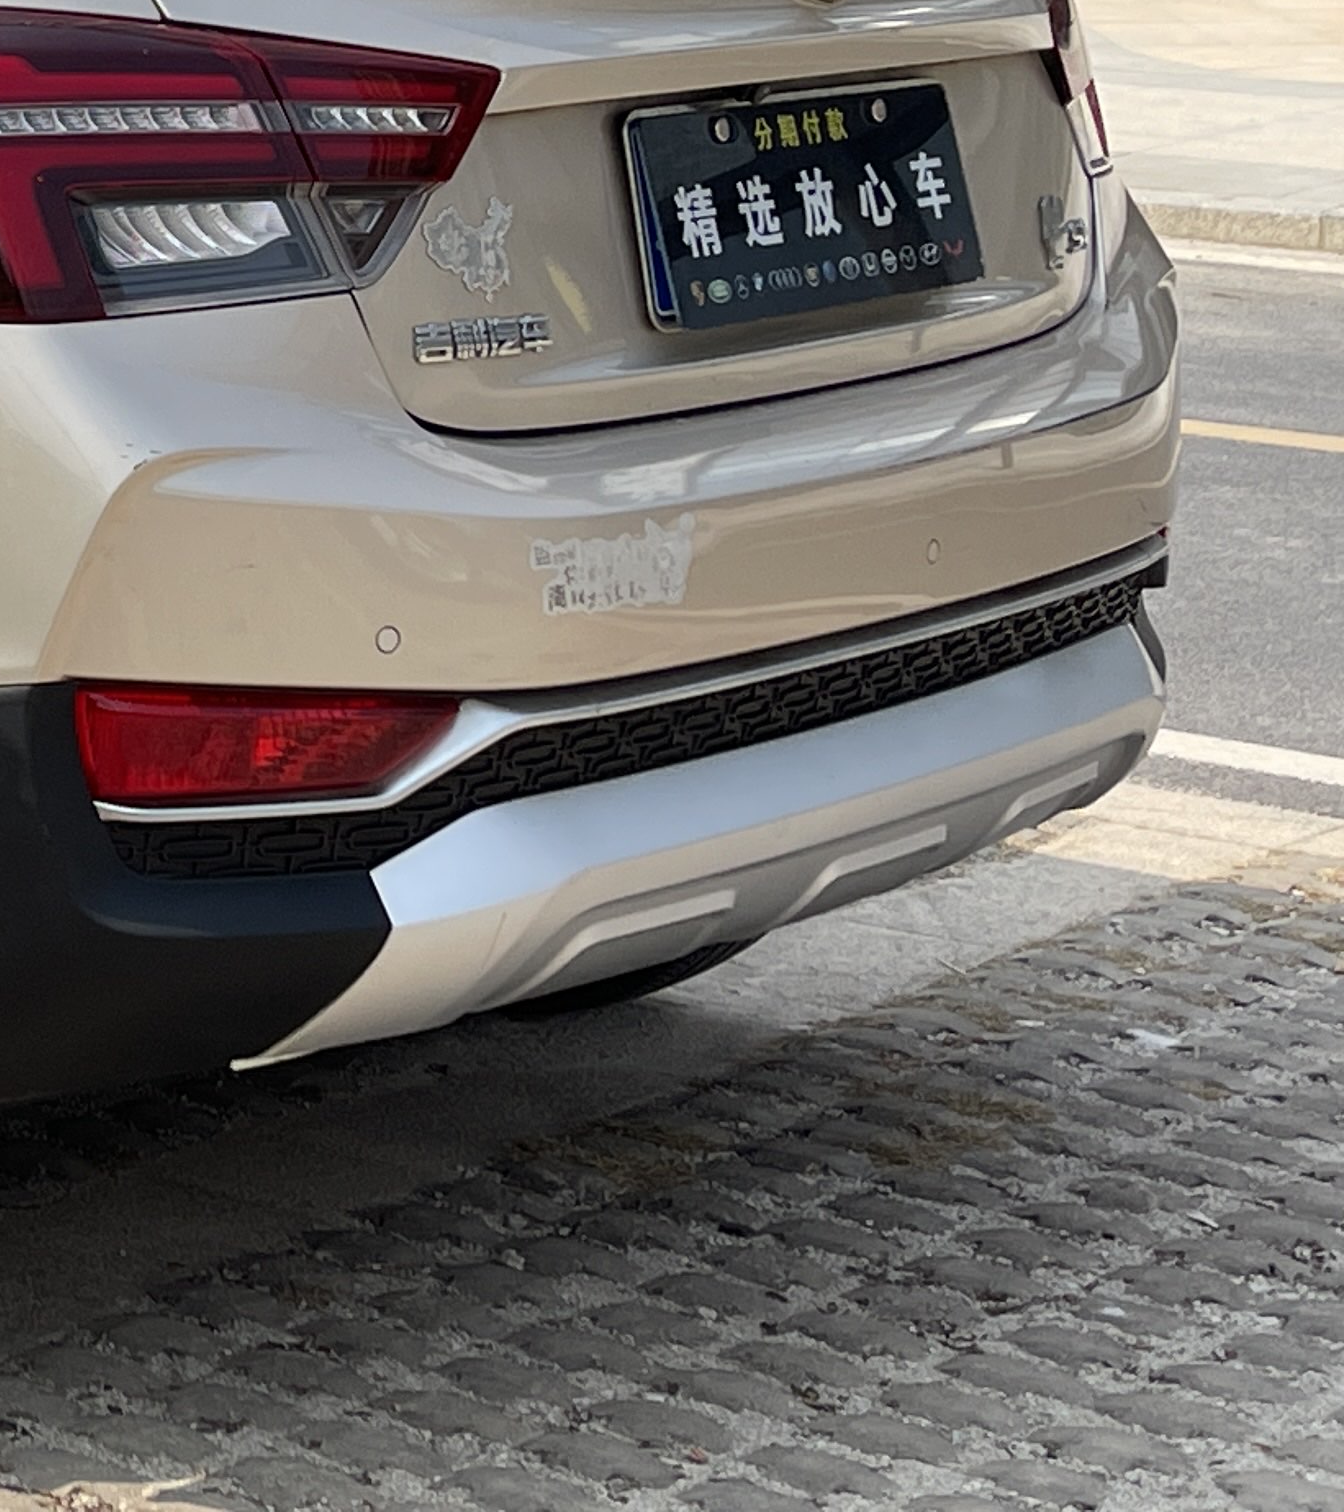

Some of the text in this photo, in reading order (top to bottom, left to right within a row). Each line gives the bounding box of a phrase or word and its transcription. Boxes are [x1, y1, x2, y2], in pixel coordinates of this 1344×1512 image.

[753, 106, 849, 151] 分期付款
[672, 150, 953, 259] 精选放心车
